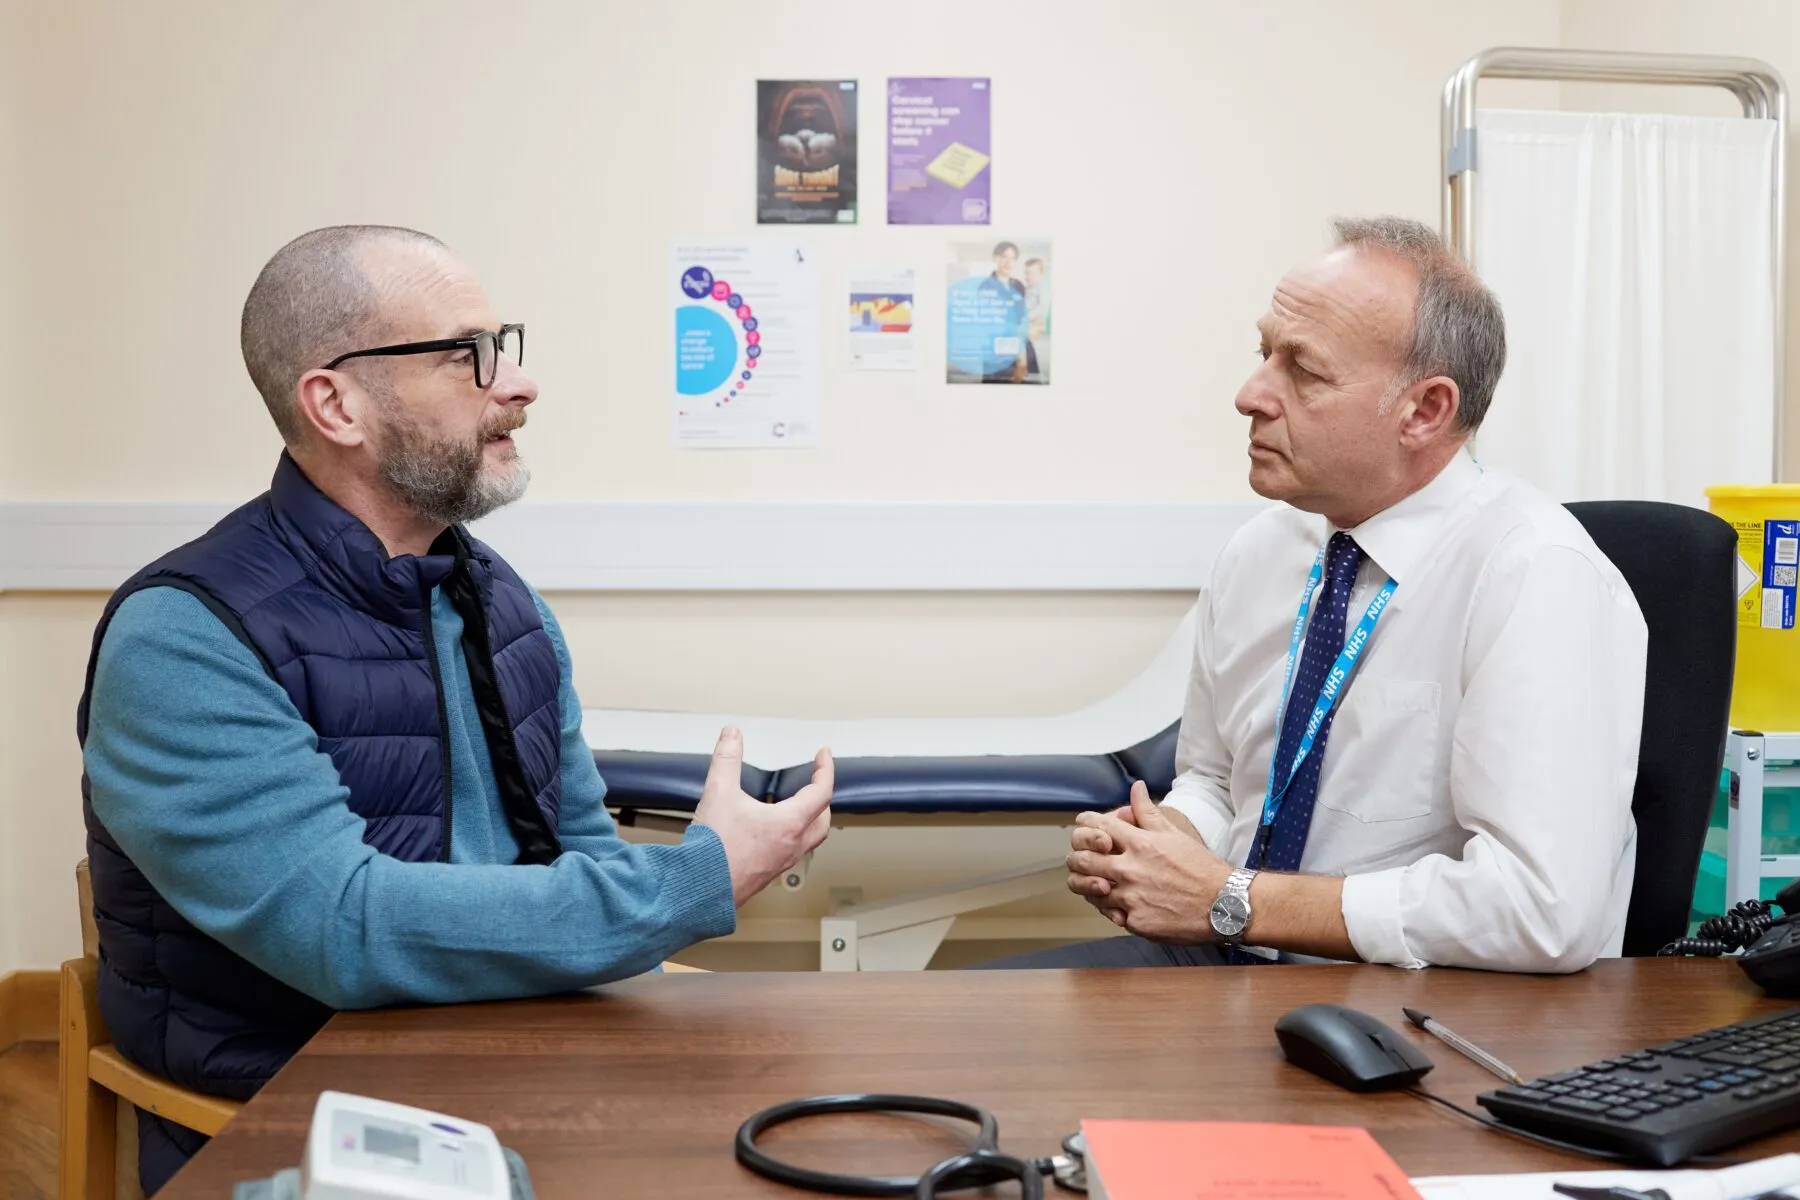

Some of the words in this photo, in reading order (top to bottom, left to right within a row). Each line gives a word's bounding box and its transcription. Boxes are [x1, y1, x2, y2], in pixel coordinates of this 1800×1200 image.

[1302, 576, 1317, 605] NHS
[1367, 589, 1391, 620] NHS
[1343, 627, 1367, 661] NHS
[1323, 666, 1345, 701] NHS
[1306, 706, 1324, 740] NHS
